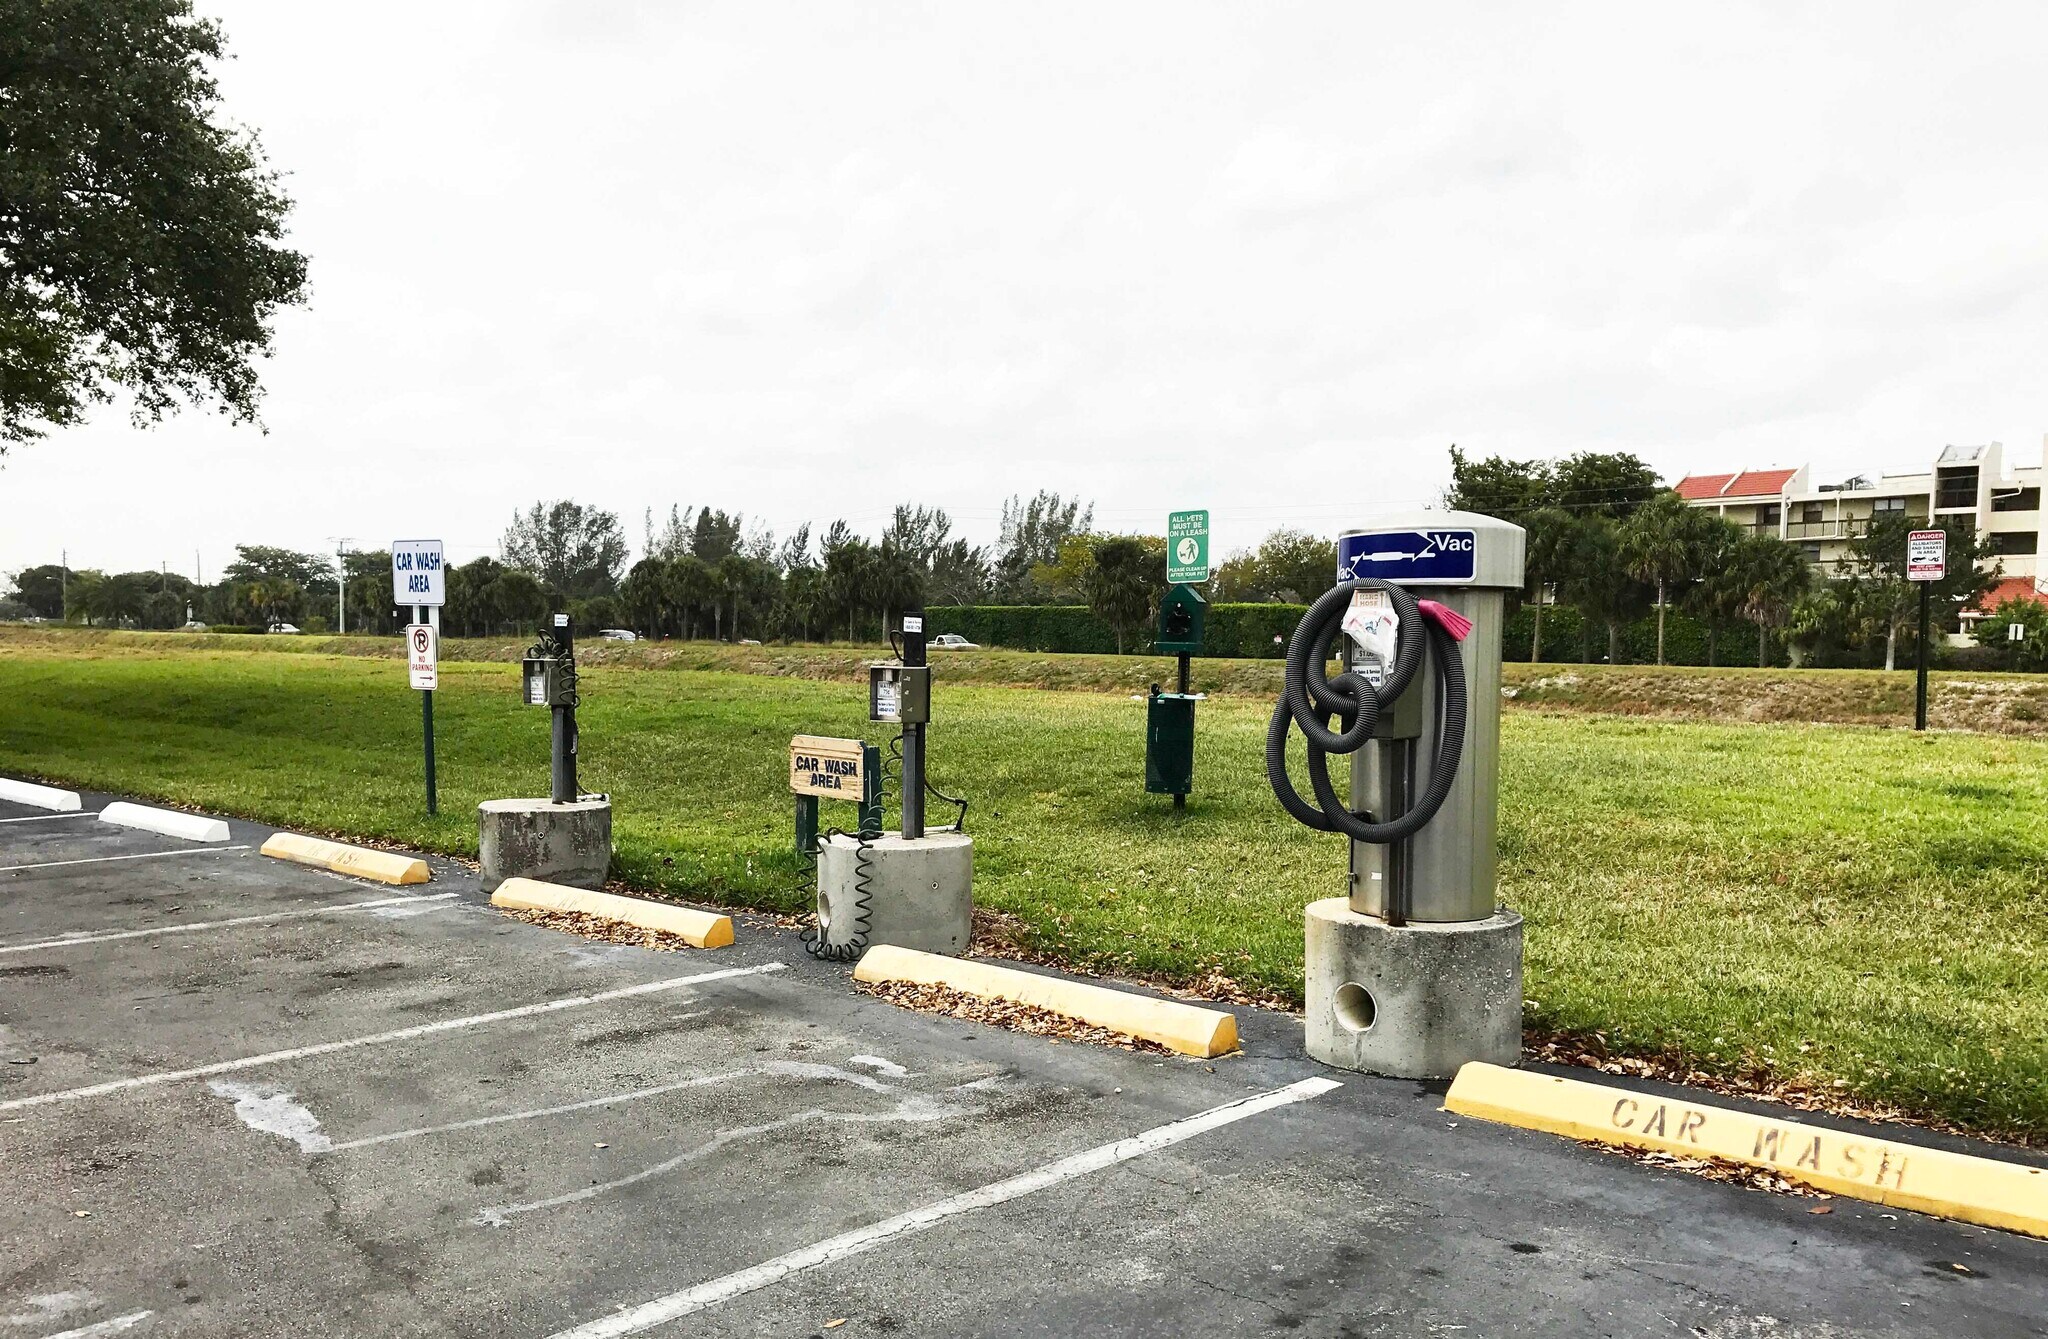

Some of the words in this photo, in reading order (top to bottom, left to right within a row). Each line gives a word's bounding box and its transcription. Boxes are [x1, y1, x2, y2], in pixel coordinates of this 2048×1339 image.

[1434, 534, 1472, 551] Vac
[396, 552, 412, 571] CAR
[415, 552, 440, 571] WASH
[408, 574, 430, 593] AREA
[412, 663, 433, 672] PARKING
[796, 756, 819, 772] CAR
[825, 759, 857, 776] WASH
[810, 772, 842, 790] AREA
[1611, 1097, 1707, 1144] CAR
[1752, 1125, 1908, 1190] WASH
